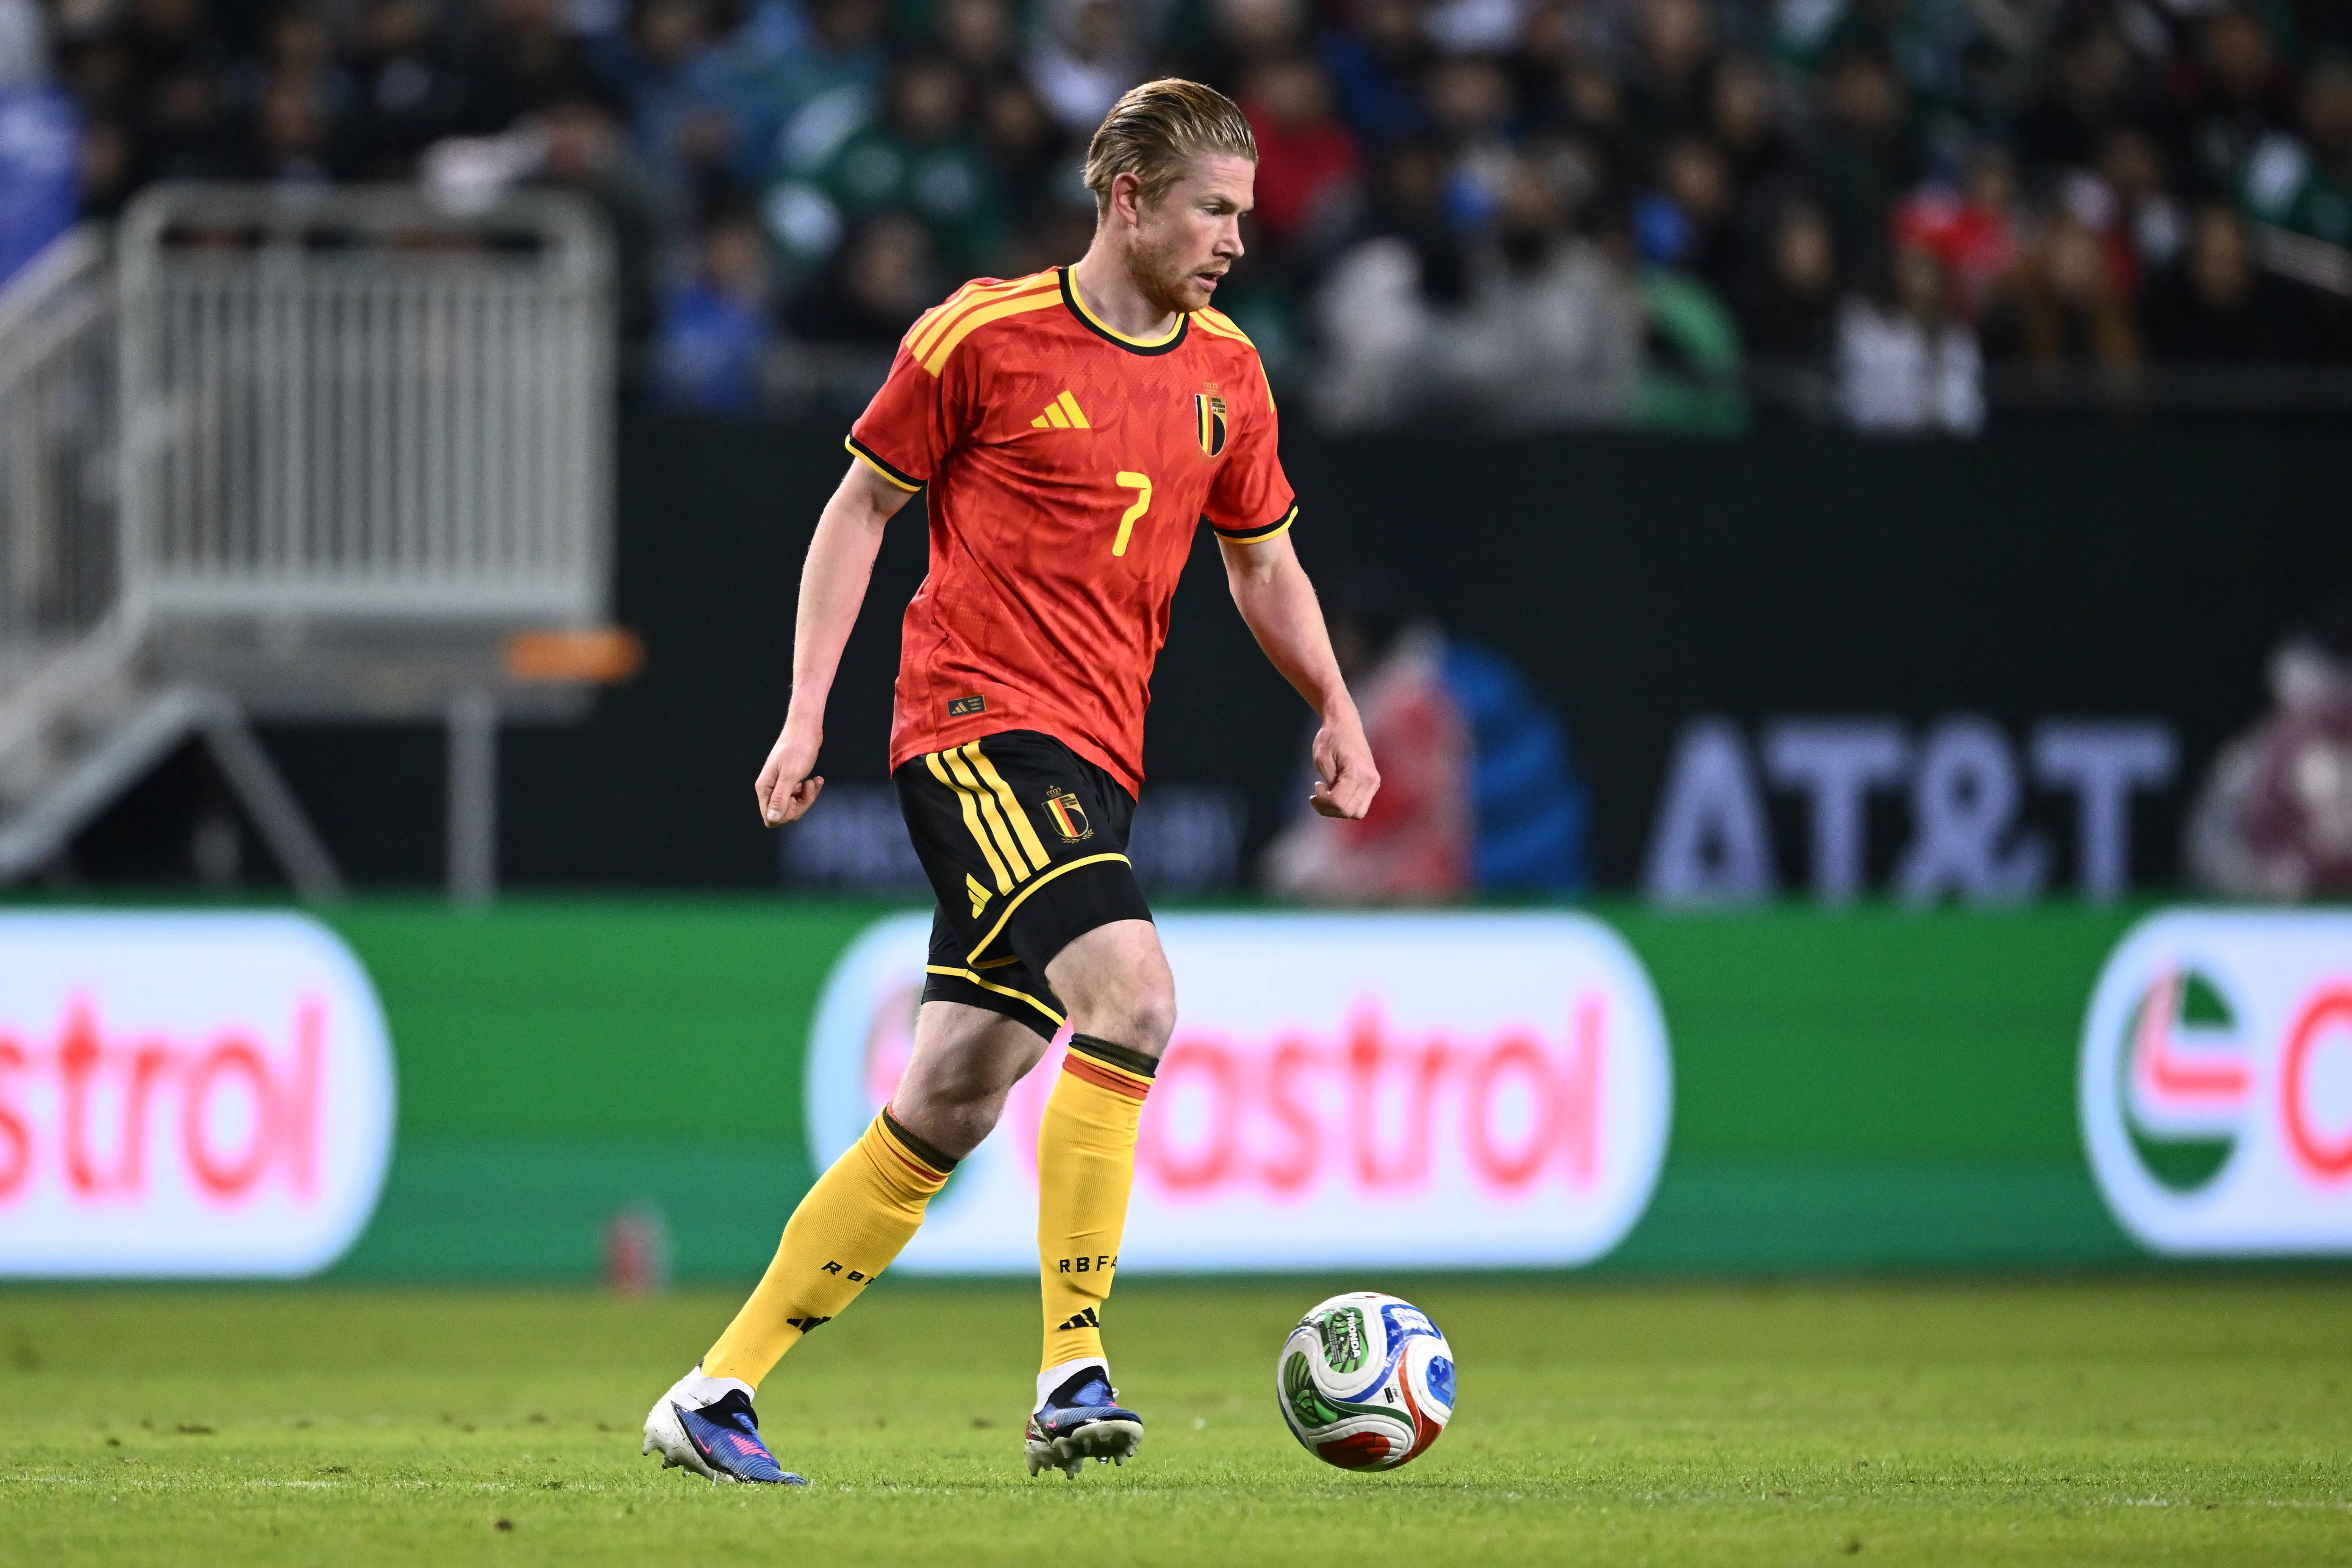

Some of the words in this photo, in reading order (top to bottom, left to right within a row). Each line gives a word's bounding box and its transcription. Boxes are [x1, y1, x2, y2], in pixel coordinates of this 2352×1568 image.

[1113, 471, 1152, 556] 7
[1646, 720, 2178, 905] AT&T
[1017, 998, 1602, 1199] astrol
[1346, 1311, 1361, 1359] TRIONDA
